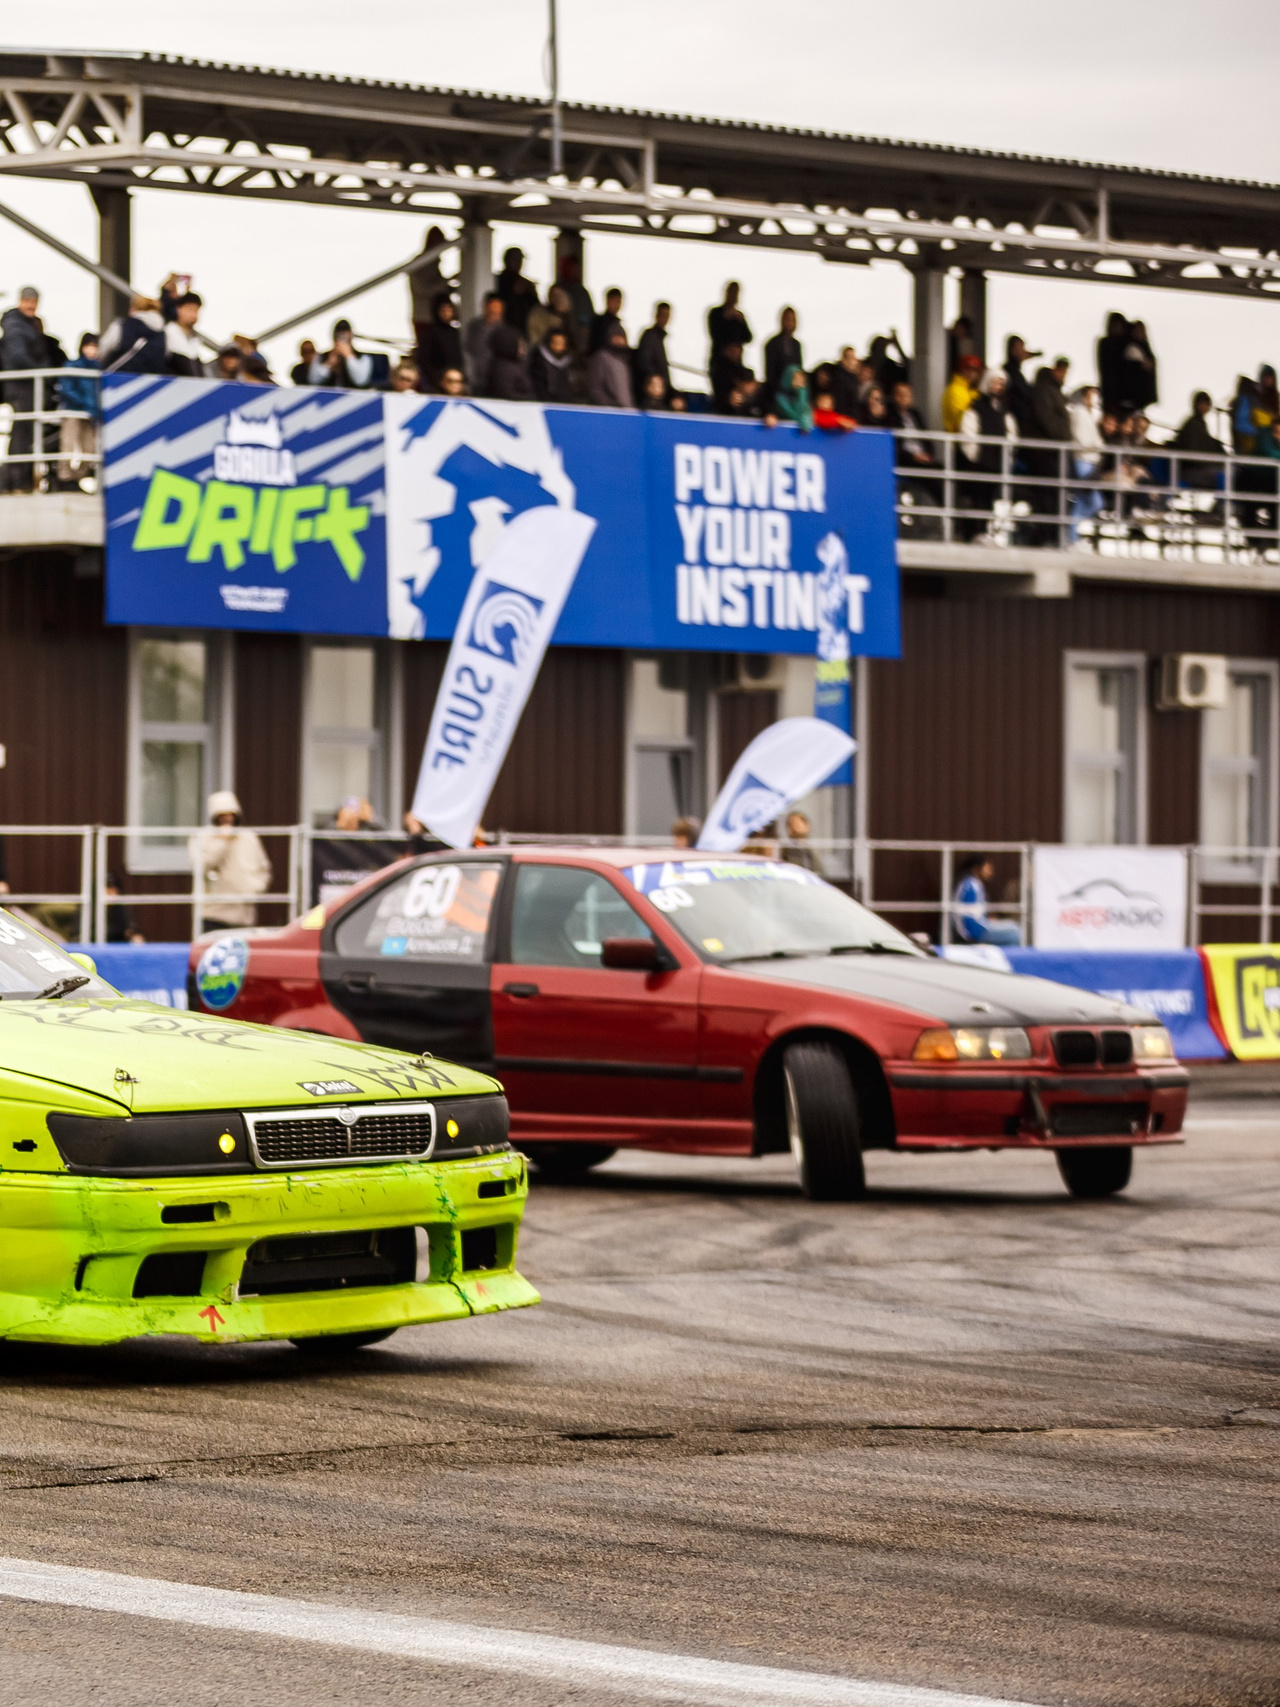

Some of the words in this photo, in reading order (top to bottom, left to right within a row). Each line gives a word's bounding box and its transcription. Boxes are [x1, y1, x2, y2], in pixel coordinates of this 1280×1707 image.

[214, 445, 297, 487] GORILLA
[674, 443, 827, 513] POWER
[132, 467, 371, 582] DRIFT
[675, 503, 792, 570] YOUR
[675, 563, 871, 634] INSTINT
[403, 866, 463, 918] 60
